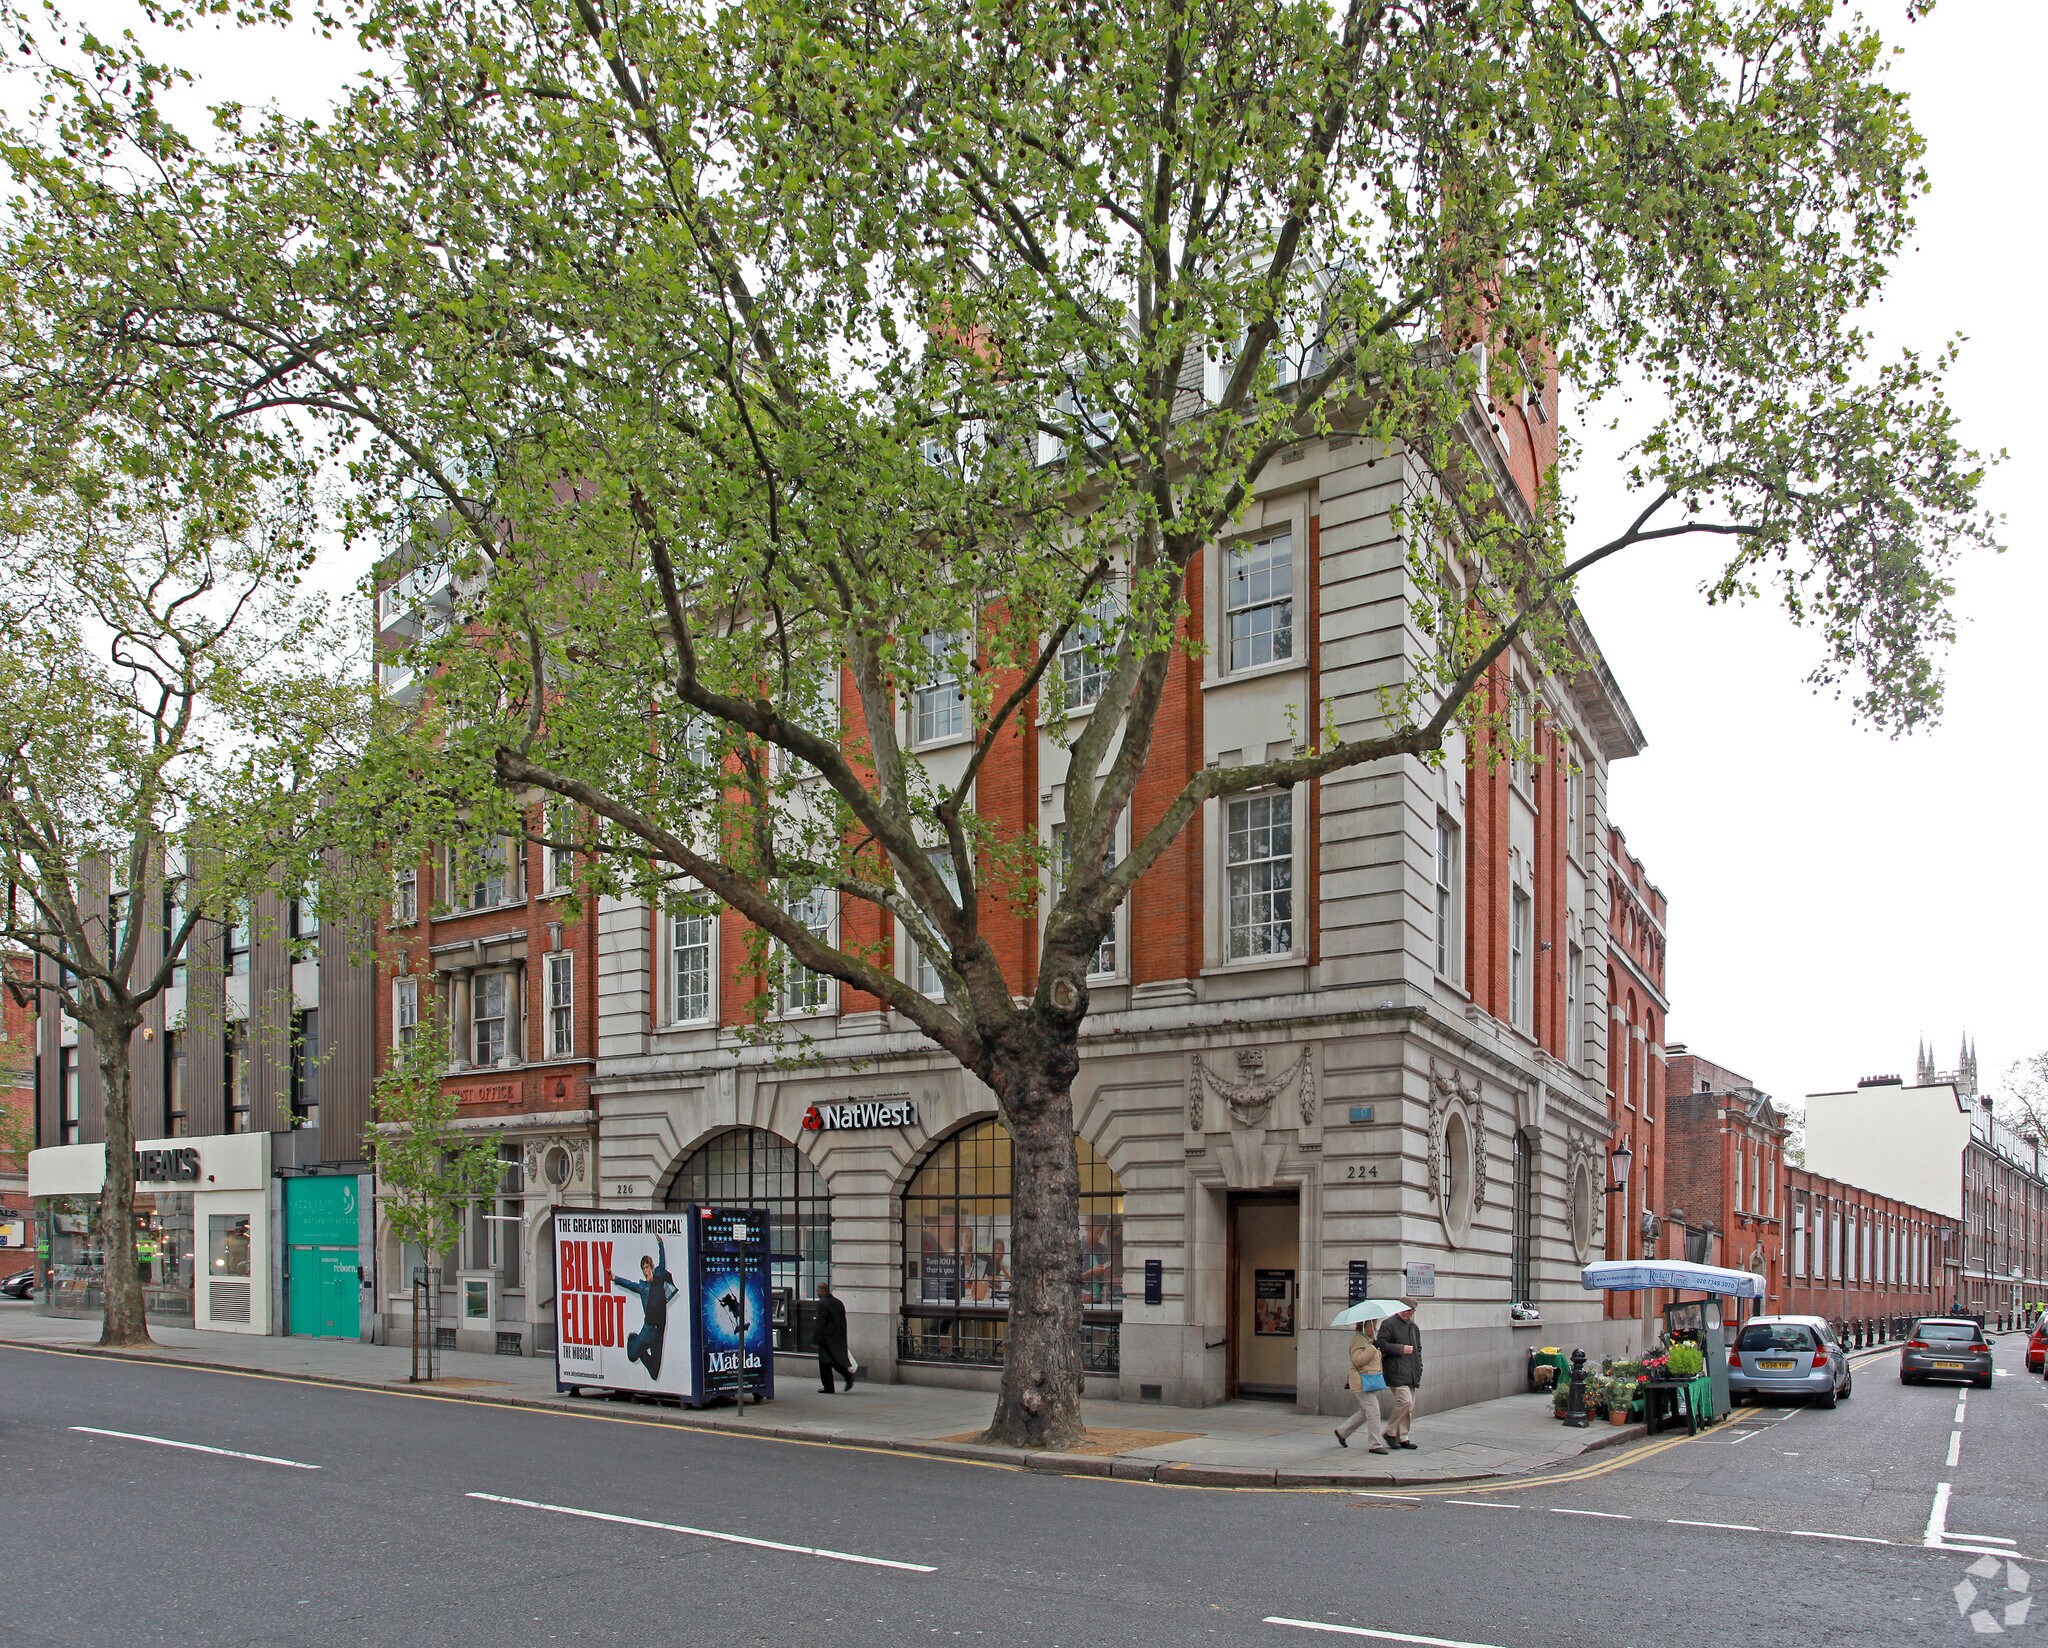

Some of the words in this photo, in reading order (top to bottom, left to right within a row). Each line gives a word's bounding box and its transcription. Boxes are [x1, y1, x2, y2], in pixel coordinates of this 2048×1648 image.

[479, 1085, 513, 1101] OFFICE
[826, 1101, 910, 1128] NatWest
[134, 1147, 201, 1181] HEAL'S
[1347, 1165, 1378, 1179] 224
[617, 1185, 634, 1195] 226
[289, 1200, 334, 1215] MERMAID
[303, 1217, 333, 1225] MATERNITY
[558, 1218, 571, 1233] THE
[573, 1218, 609, 1233] GREATEST
[611, 1219, 643, 1234] BRITISH
[560, 1240, 613, 1293] BILLY
[943, 1268, 955, 1276] you
[1408, 1277, 1421, 1285] CHELSEA
[1721, 1281, 1735, 1289] 3070
[561, 1293, 626, 1348] ELLIOT
[563, 1345, 572, 1359] THE
[572, 1346, 594, 1361] MUSICAL
[708, 1349, 762, 1373] Matlda
